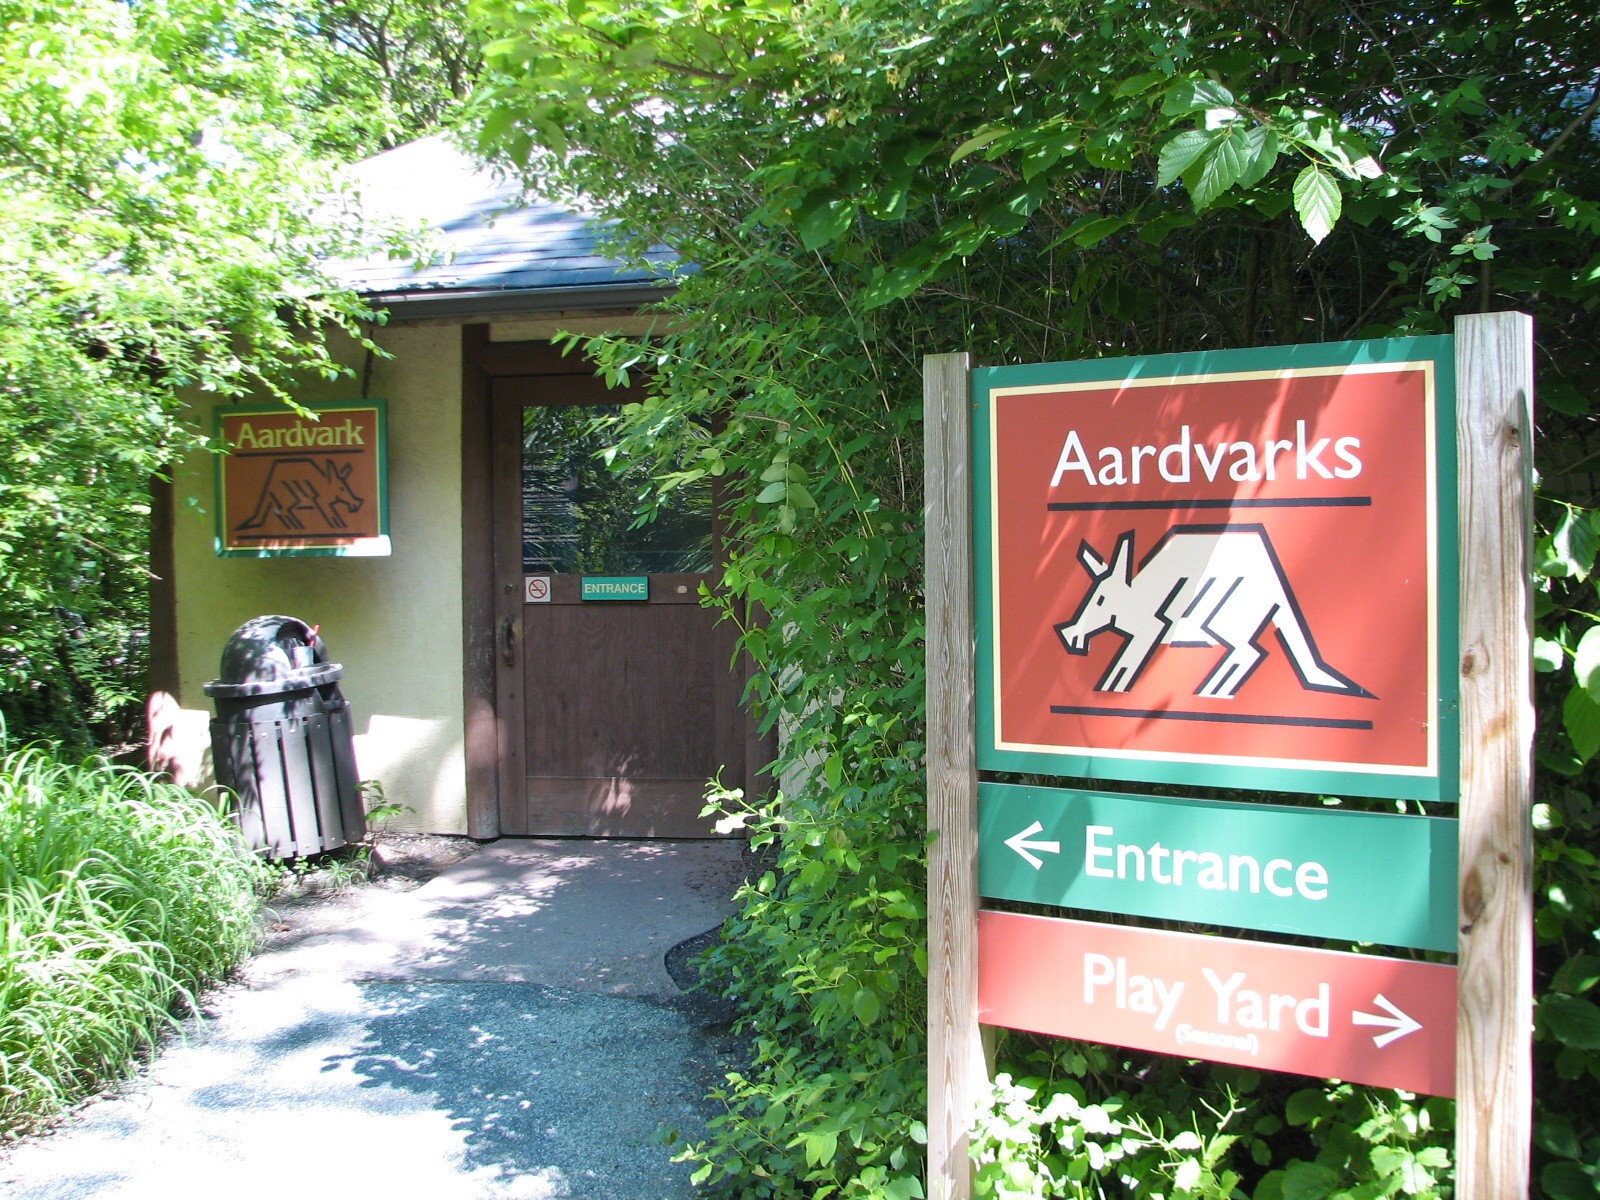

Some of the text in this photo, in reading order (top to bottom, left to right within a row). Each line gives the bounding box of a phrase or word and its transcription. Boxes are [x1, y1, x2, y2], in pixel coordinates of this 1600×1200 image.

[236, 418, 365, 449] Aardvark
[1050, 419, 1363, 487] Aardvarks
[584, 583, 646, 594] ENTRANCE
[1085, 825, 1329, 900] Entrance
[1083, 953, 1330, 1037] Play Yard
